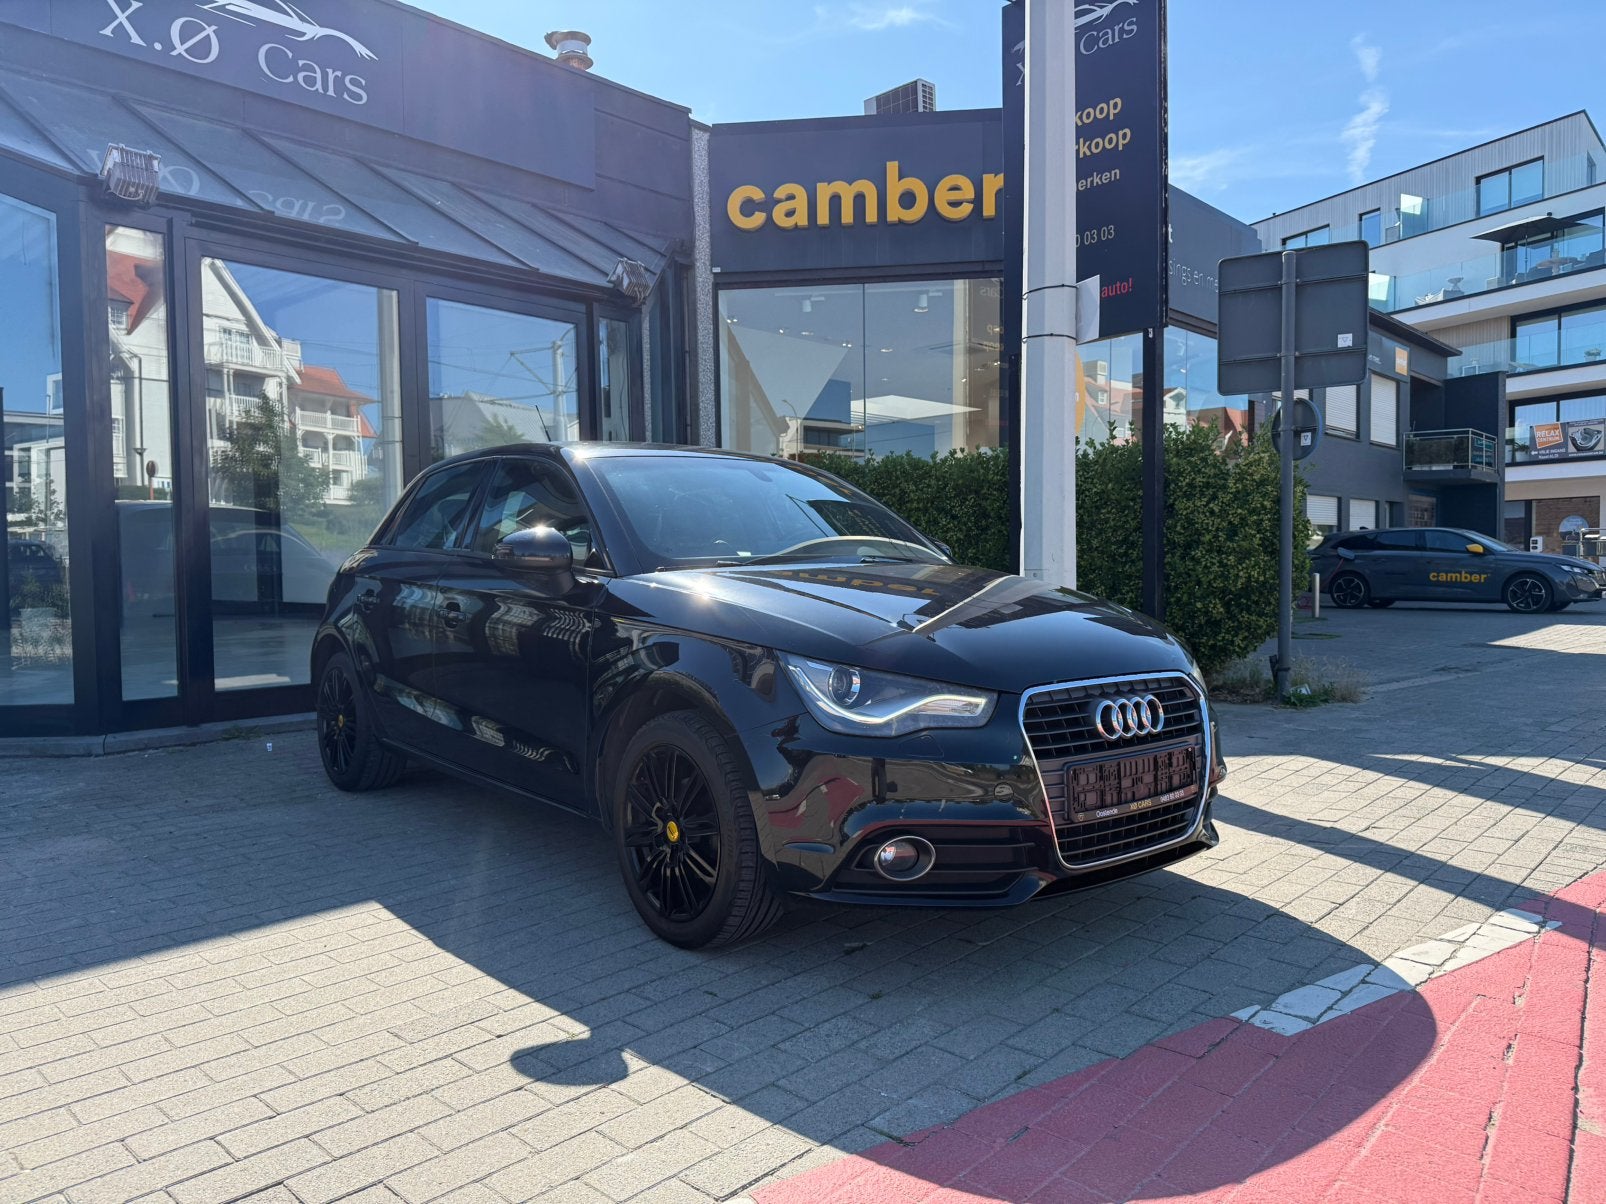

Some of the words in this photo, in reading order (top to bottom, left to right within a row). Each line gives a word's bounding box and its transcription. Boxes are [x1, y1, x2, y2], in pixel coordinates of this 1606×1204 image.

[1079, 17, 1138, 55] Cars
[257, 43, 368, 105] Cars
[1076, 168, 1120, 191] erken
[727, 161, 1004, 231] camber
[1084, 229, 1098, 246] 03
[1100, 224, 1115, 241] 03
[1101, 278, 1133, 298] auto!
[1536, 429, 1560, 438] RELAX
[1429, 570, 1487, 583] camber
